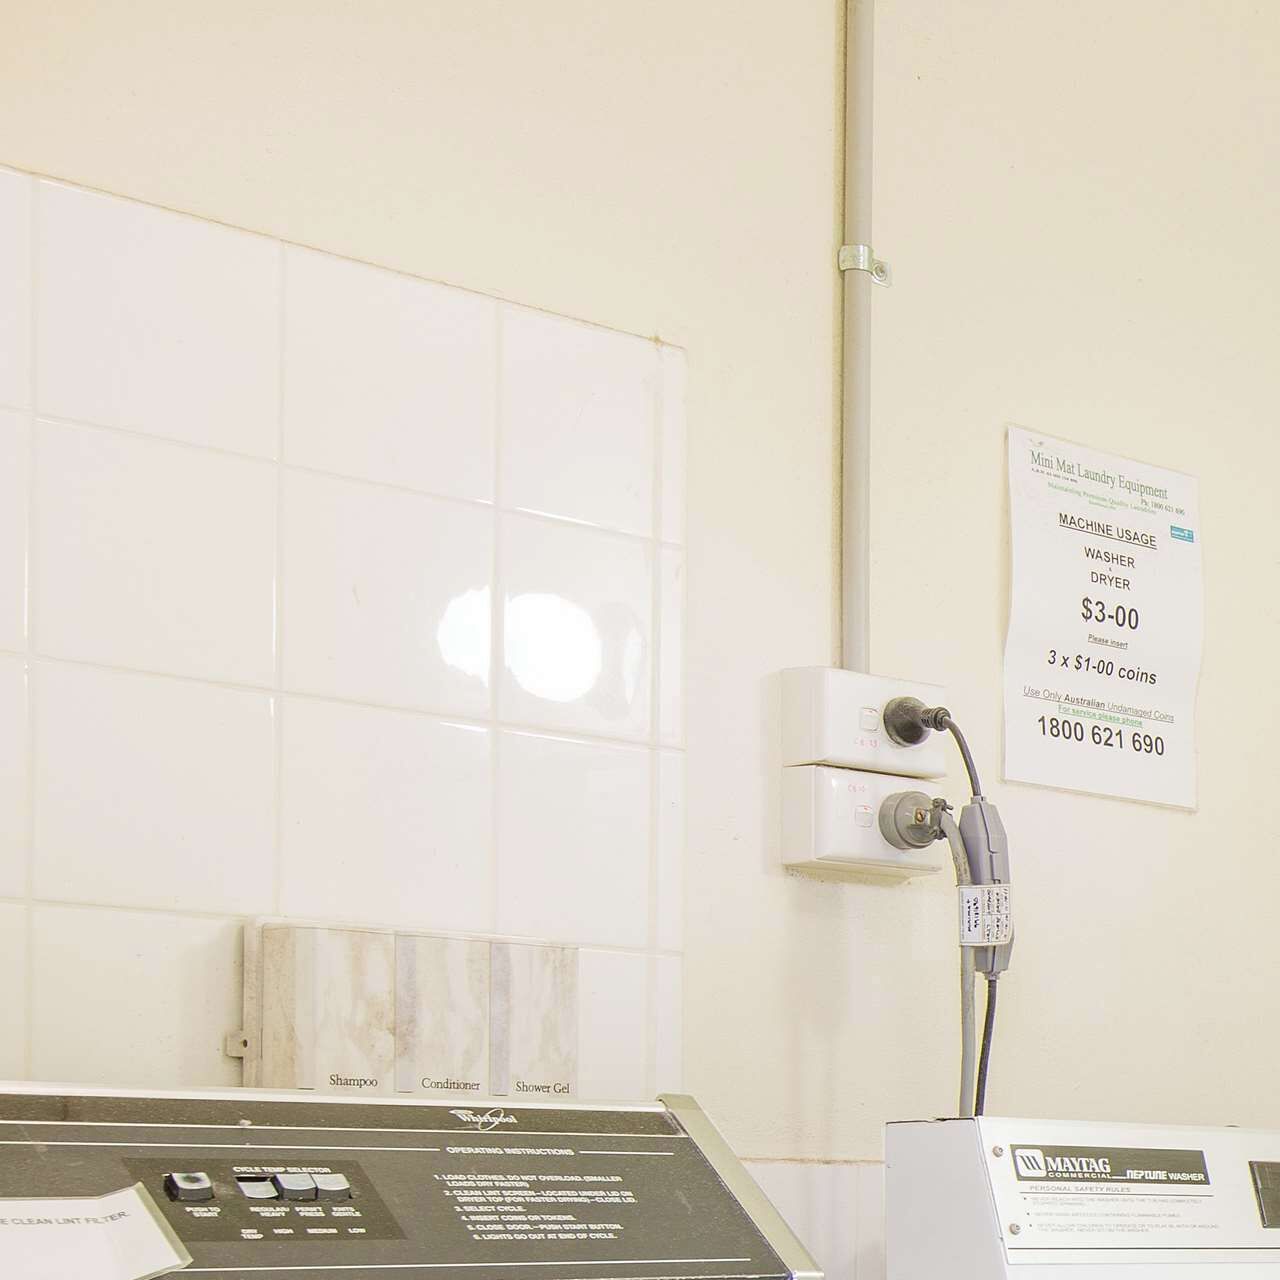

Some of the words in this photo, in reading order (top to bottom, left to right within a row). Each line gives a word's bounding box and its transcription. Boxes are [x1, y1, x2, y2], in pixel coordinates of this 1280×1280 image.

[1031, 450, 1053, 469] Mini
[1057, 456, 1075, 475] Mat
[1078, 463, 1115, 488] Laundry
[1119, 475, 1168, 499] Equipment
[1059, 513, 1112, 536] MACHINE
[1117, 527, 1156, 546] USAGE
[1085, 547, 1135, 568] WASHER
[1091, 571, 1130, 590] DRYER
[1082, 597, 1139, 629] $3-00
[1088, 634, 1108, 644] Please
[1111, 638, 1128, 648] insert
[1048, 650, 1056, 664] 3
[1061, 656, 1069, 667] x
[1075, 654, 1113, 675] $1-00
[1119, 667, 1157, 684] coins
[1024, 686, 1040, 697] Use
[1043, 689, 1062, 702] Only
[1064, 694, 1105, 708] Australian
[1108, 703, 1151, 718] Undamaged
[1154, 711, 1174, 721] Coins
[1038, 715, 1084, 741] 1800
[1092, 725, 1123, 748] 621
[1132, 733, 1164, 755] 690
[329, 1074, 378, 1088] Shampoo
[422, 1078, 480, 1091] Conditioner
[516, 1082, 550, 1093] Shower
[553, 1082, 569, 1094] Gel
[450, 1109, 518, 1129] Whirlpool
[446, 1147, 503, 1155] OPERATING
[504, 1147, 574, 1156] INSTRUCTIONS
[1045, 1157, 1111, 1173] MAYTAG
[1126, 1170, 1167, 1180] NEPTUNE
[1169, 1173, 1204, 1181] WASHER
